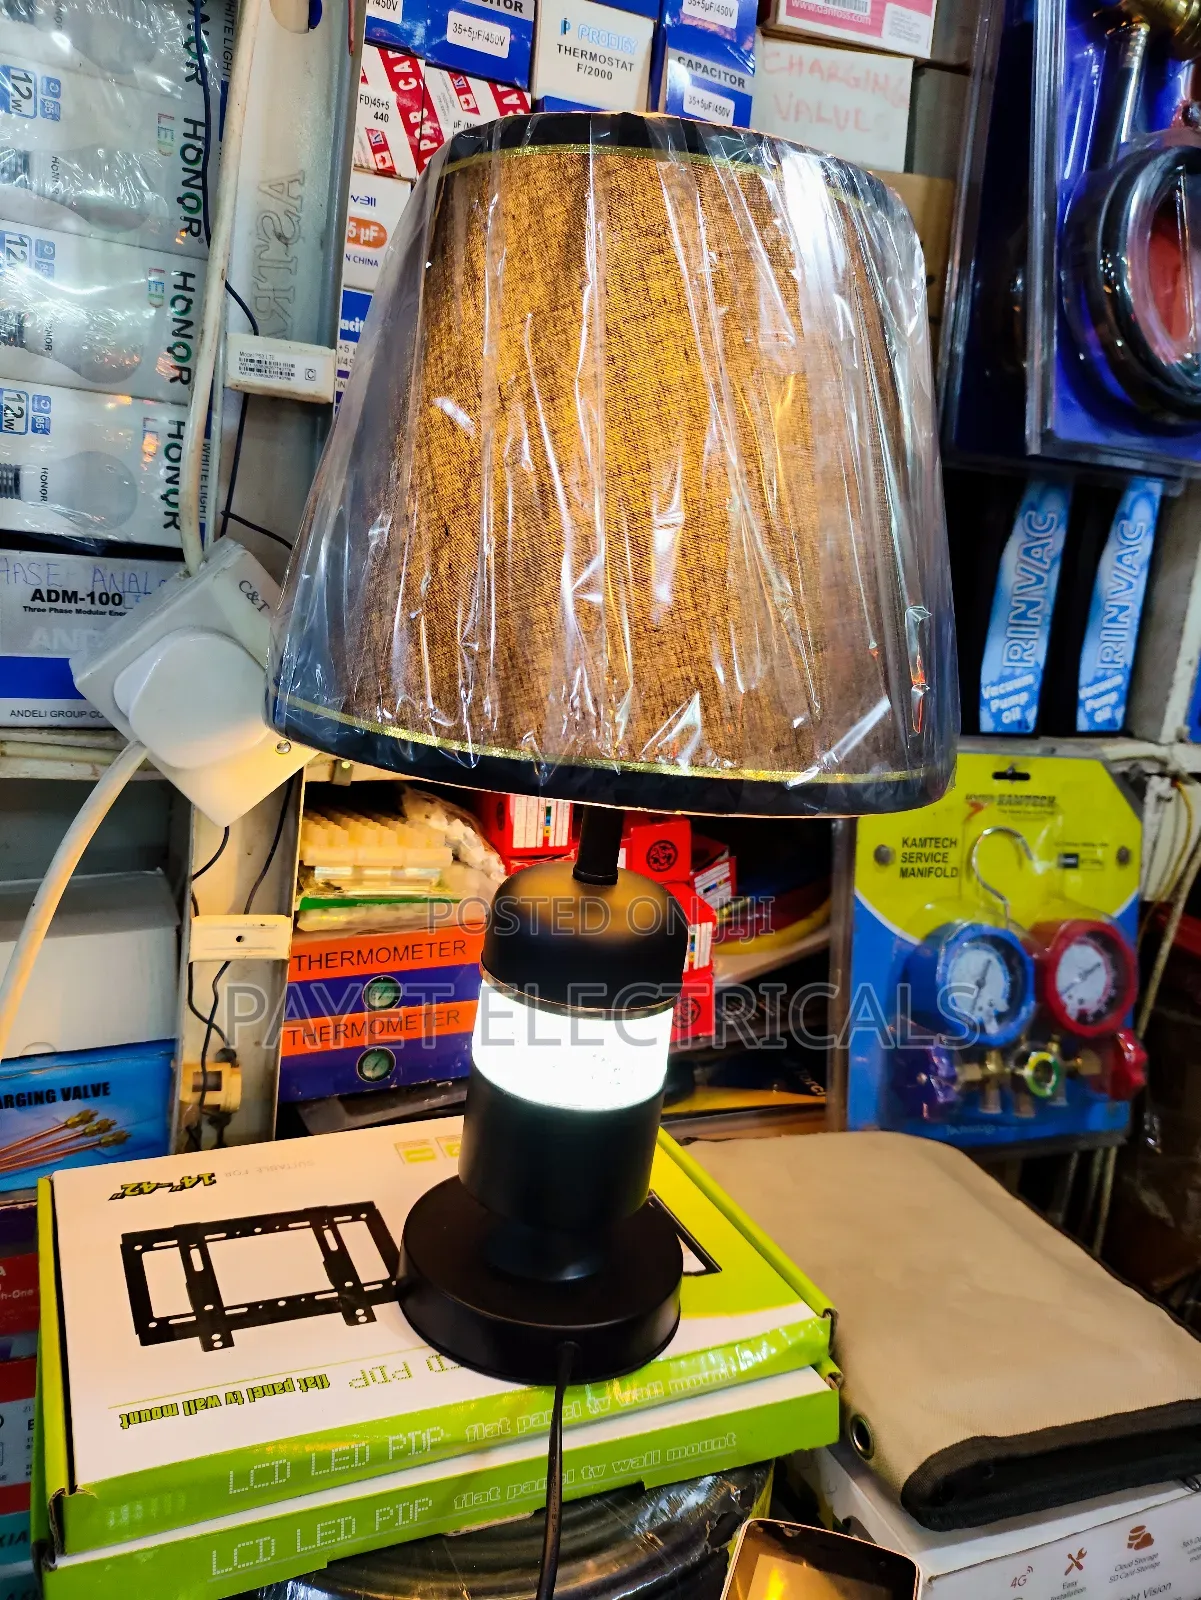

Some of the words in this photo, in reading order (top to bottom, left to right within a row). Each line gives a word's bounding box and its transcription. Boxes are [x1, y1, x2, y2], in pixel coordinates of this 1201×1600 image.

[578, 23, 638, 56] PRODIGY
[557, 43, 635, 72] THERMOSTAT
[576, 62, 614, 81] F/2000
[677, 55, 745, 89] CAPACITOR
[373, 111, 390, 123] 440
[176, 117, 207, 239] HONOR
[353, 255, 379, 268] CHINA
[167, 270, 196, 387] HONOR
[30, 588, 123, 607] ADM-100
[1002, 510, 1059, 668] RINVAC
[1096, 519, 1146, 670] RINVAC
[23, 606, 47, 614] Three
[48, 607, 73, 616] Phase
[75, 608, 107, 617] Modular
[10, 710, 47, 719] ANDELI
[50, 710, 87, 719] GROUP
[901, 836, 958, 850] KAMTECH
[900, 852, 950, 865] SERVICE
[899, 866, 960, 879] MANIFOLD
[292, 939, 467, 973] THERMOMETER
[287, 1009, 461, 1046] THERMOMETER
[60, 1082, 111, 1102] VALVE
[246, 1377, 296, 1404] panel
[299, 1374, 331, 1394] flat
[182, 1394, 222, 1417] wall
[224, 1390, 245, 1407] tv
[119, 1402, 179, 1430] mount
[229, 1458, 291, 1494] LCD
[311, 1440, 370, 1476] LED
[388, 1425, 445, 1460] PDP
[466, 1418, 511, 1443] flat
[212, 1536, 275, 1576] LCD
[297, 1516, 356, 1553] LED
[375, 1497, 433, 1531] PDP
[454, 1485, 502, 1510] flat
[581, 1463, 607, 1485] tv
[612, 1448, 662, 1475] wall
[666, 1431, 738, 1462] mount
[1010, 1573, 1028, 1590] 4G
[1143, 1581, 1173, 1598] Vision
